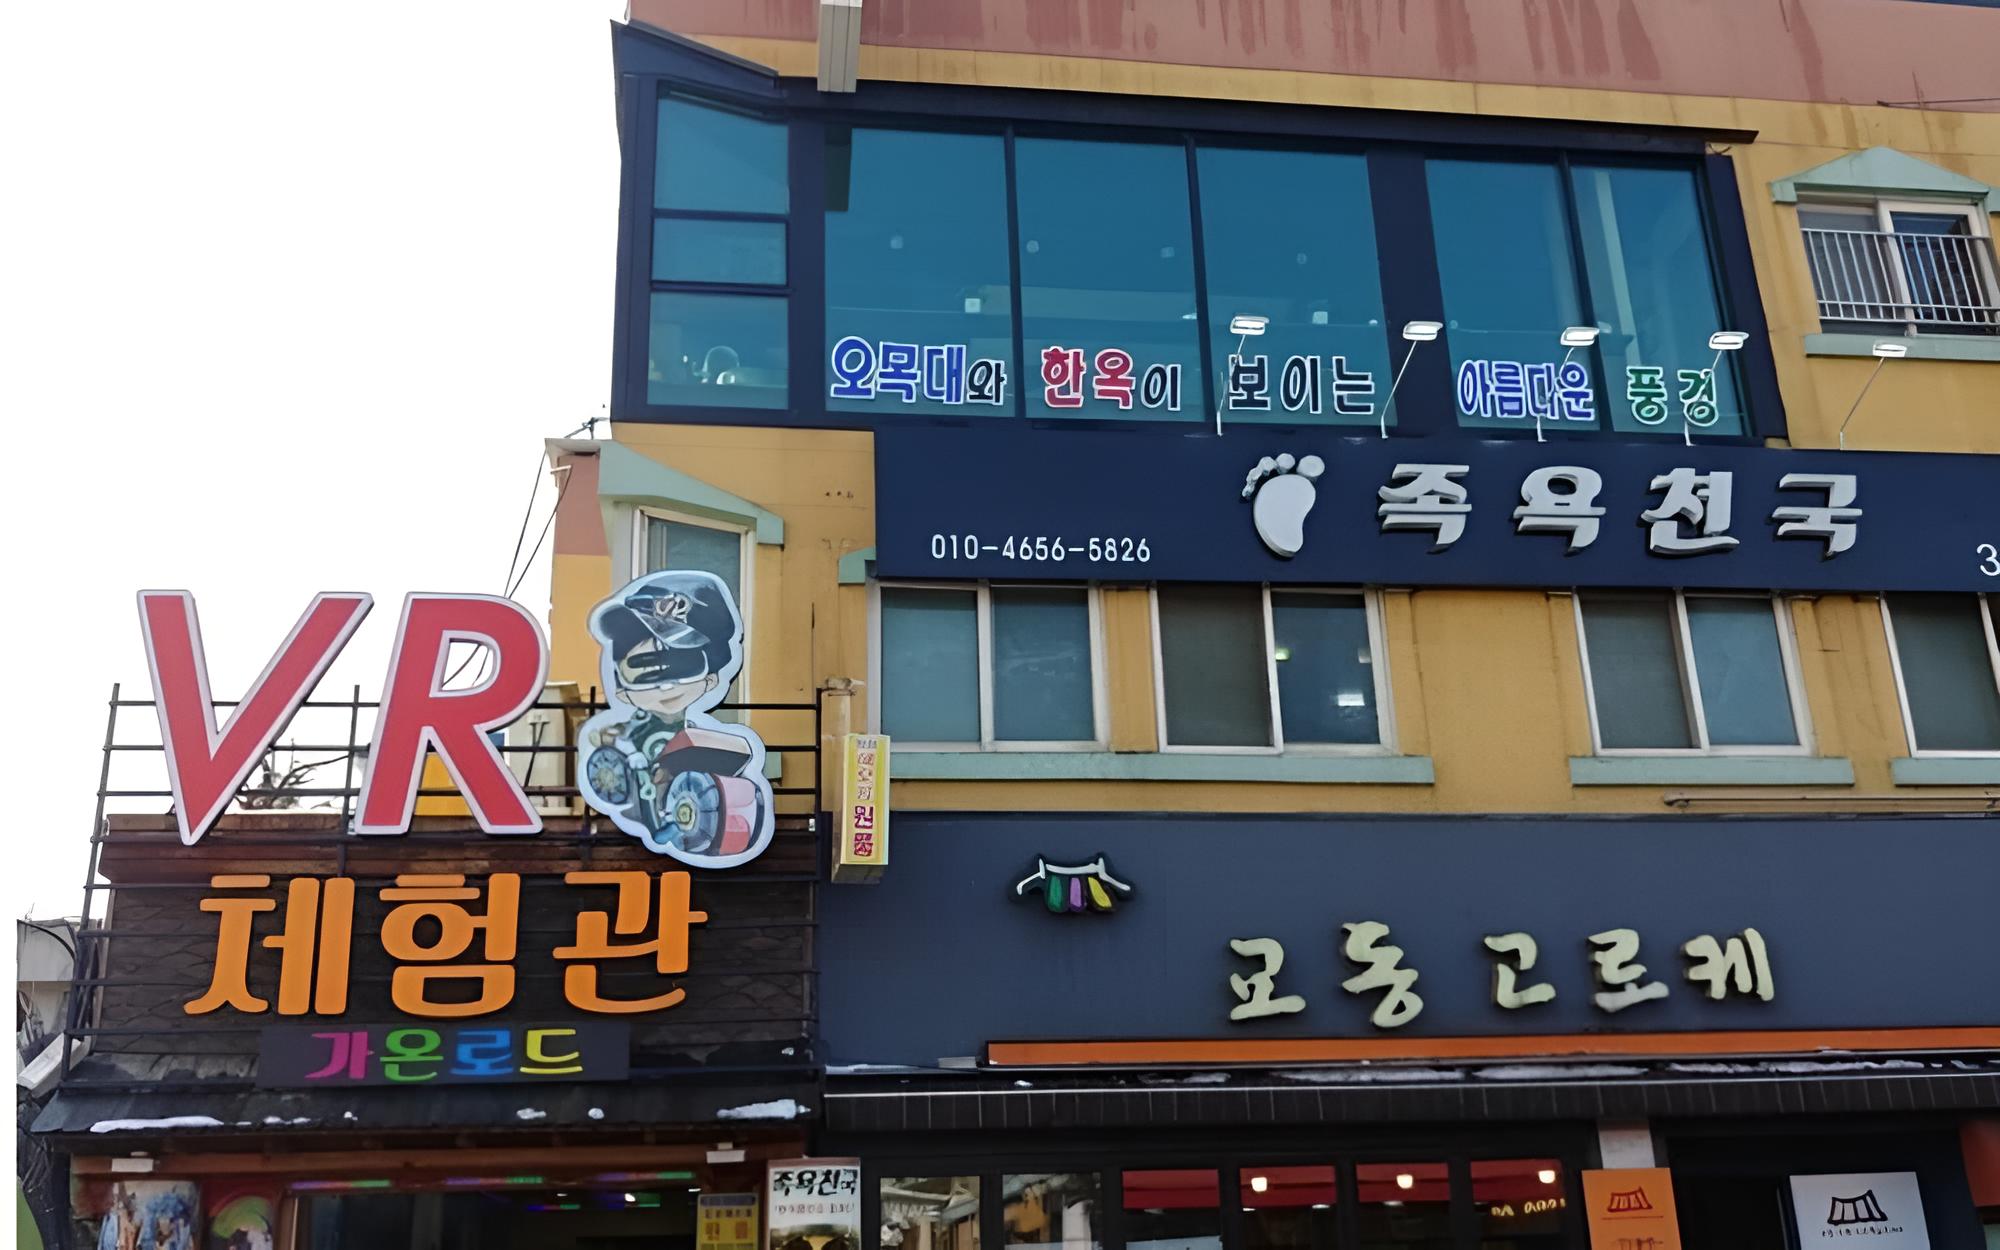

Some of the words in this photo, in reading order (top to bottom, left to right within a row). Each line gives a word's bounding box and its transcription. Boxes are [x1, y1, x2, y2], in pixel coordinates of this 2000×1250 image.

[831, 336, 1006, 405] 오목대와
[1041, 346, 1181, 411] 한옥이
[1229, 355, 1374, 415] 보이는
[1457, 359, 1595, 421] 아름다운
[1625, 365, 1720, 426] 풍경
[931, 534, 1151, 562] 010-4656-5826
[1378, 463, 1863, 559] 족욕천국
[136, 589, 550, 846] VR
[184, 871, 708, 1017] 체험관
[1229, 920, 1424, 1029] 교동
[1483, 927, 1775, 1013] 고로케
[305, 1027, 584, 1081] 가운로드
